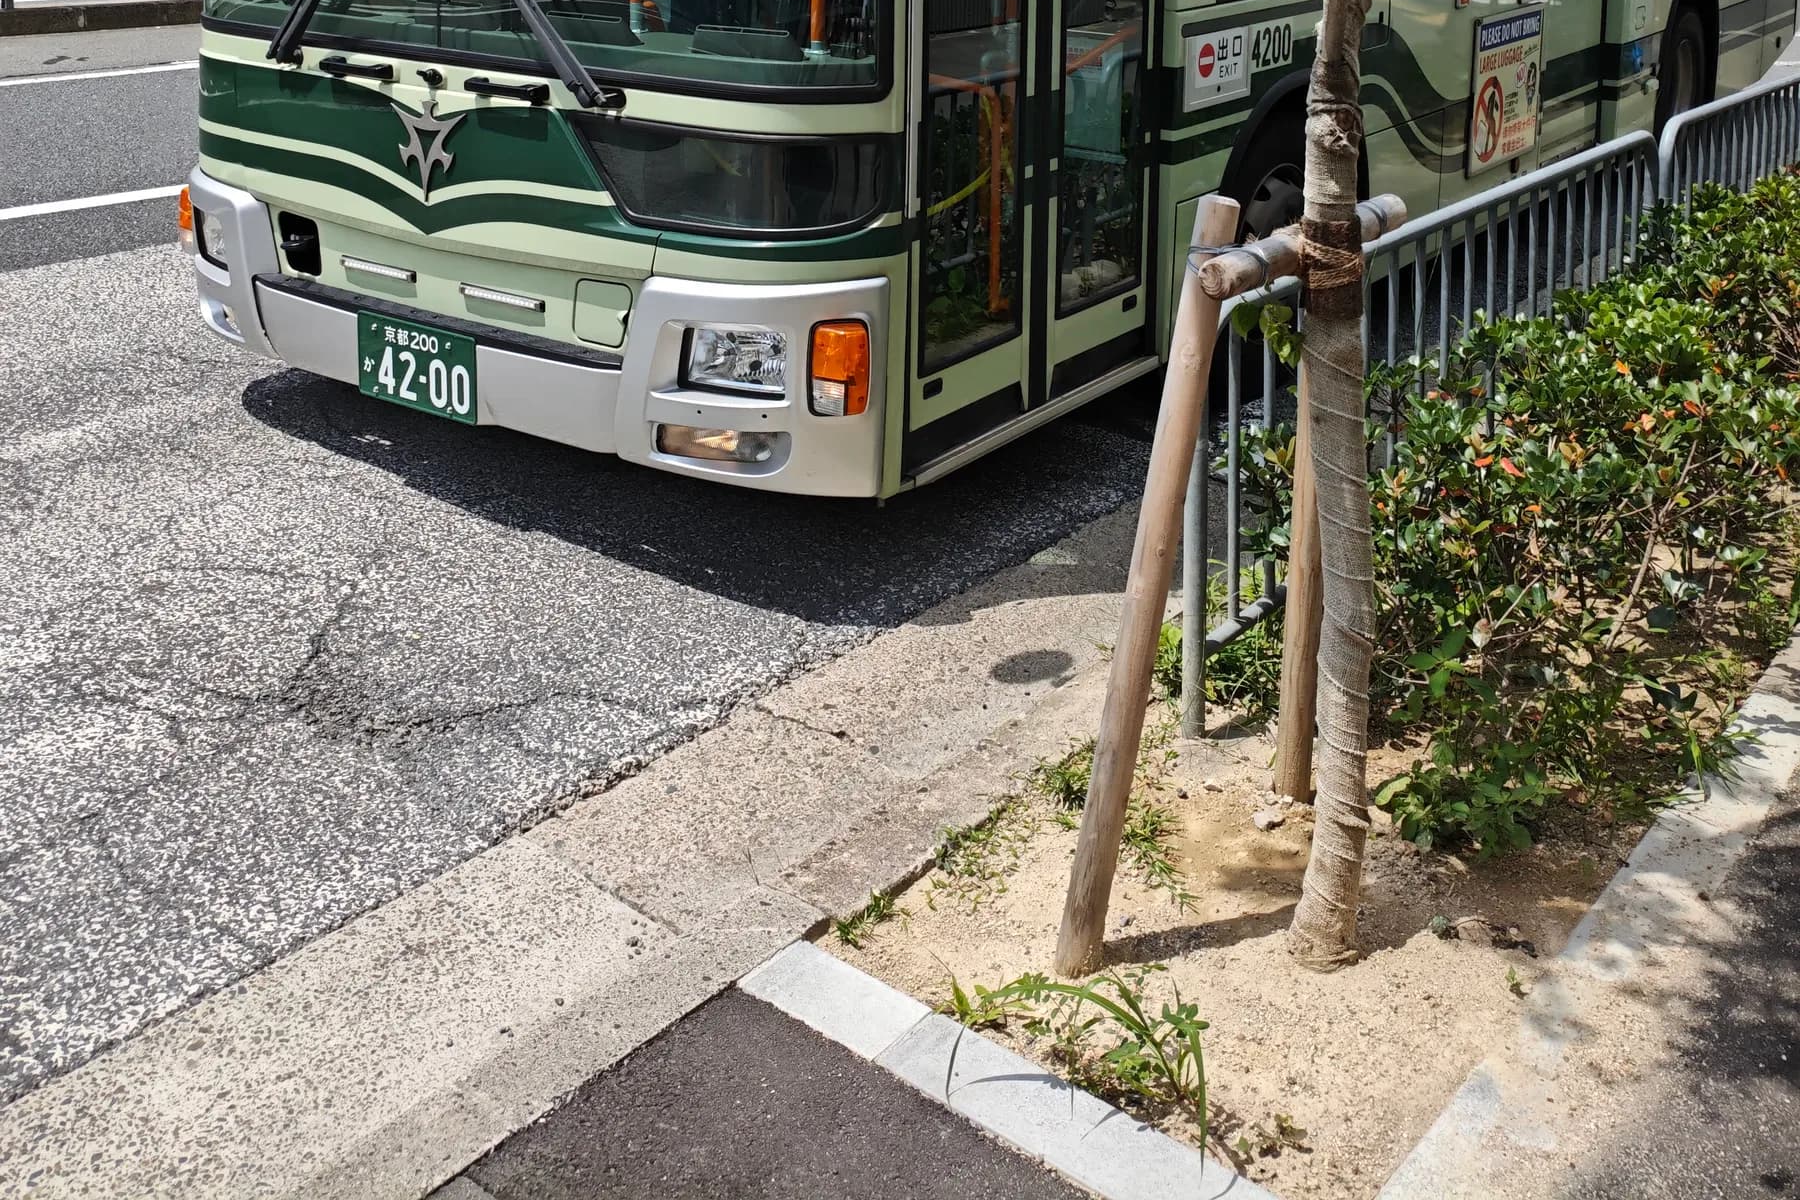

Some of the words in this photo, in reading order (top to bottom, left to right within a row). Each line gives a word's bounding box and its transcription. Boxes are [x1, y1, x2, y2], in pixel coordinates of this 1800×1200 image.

[1252, 23, 1292, 68] 4200
[1482, 25, 1502, 48] PLEASE
[1502, 23, 1511, 42] DO
[1511, 19, 1523, 39] NOT
[1523, 15, 1540, 36] BRING
[1217, 34, 1242, 61] 出口
[1480, 52, 1497, 74] LARGE
[1498, 45, 1523, 68] LUGGAGE
[1219, 62, 1238, 78] EXIT
[384, 325, 438, 354] 京都200
[363, 356, 375, 373] か
[378, 346, 470, 415] 42-00
